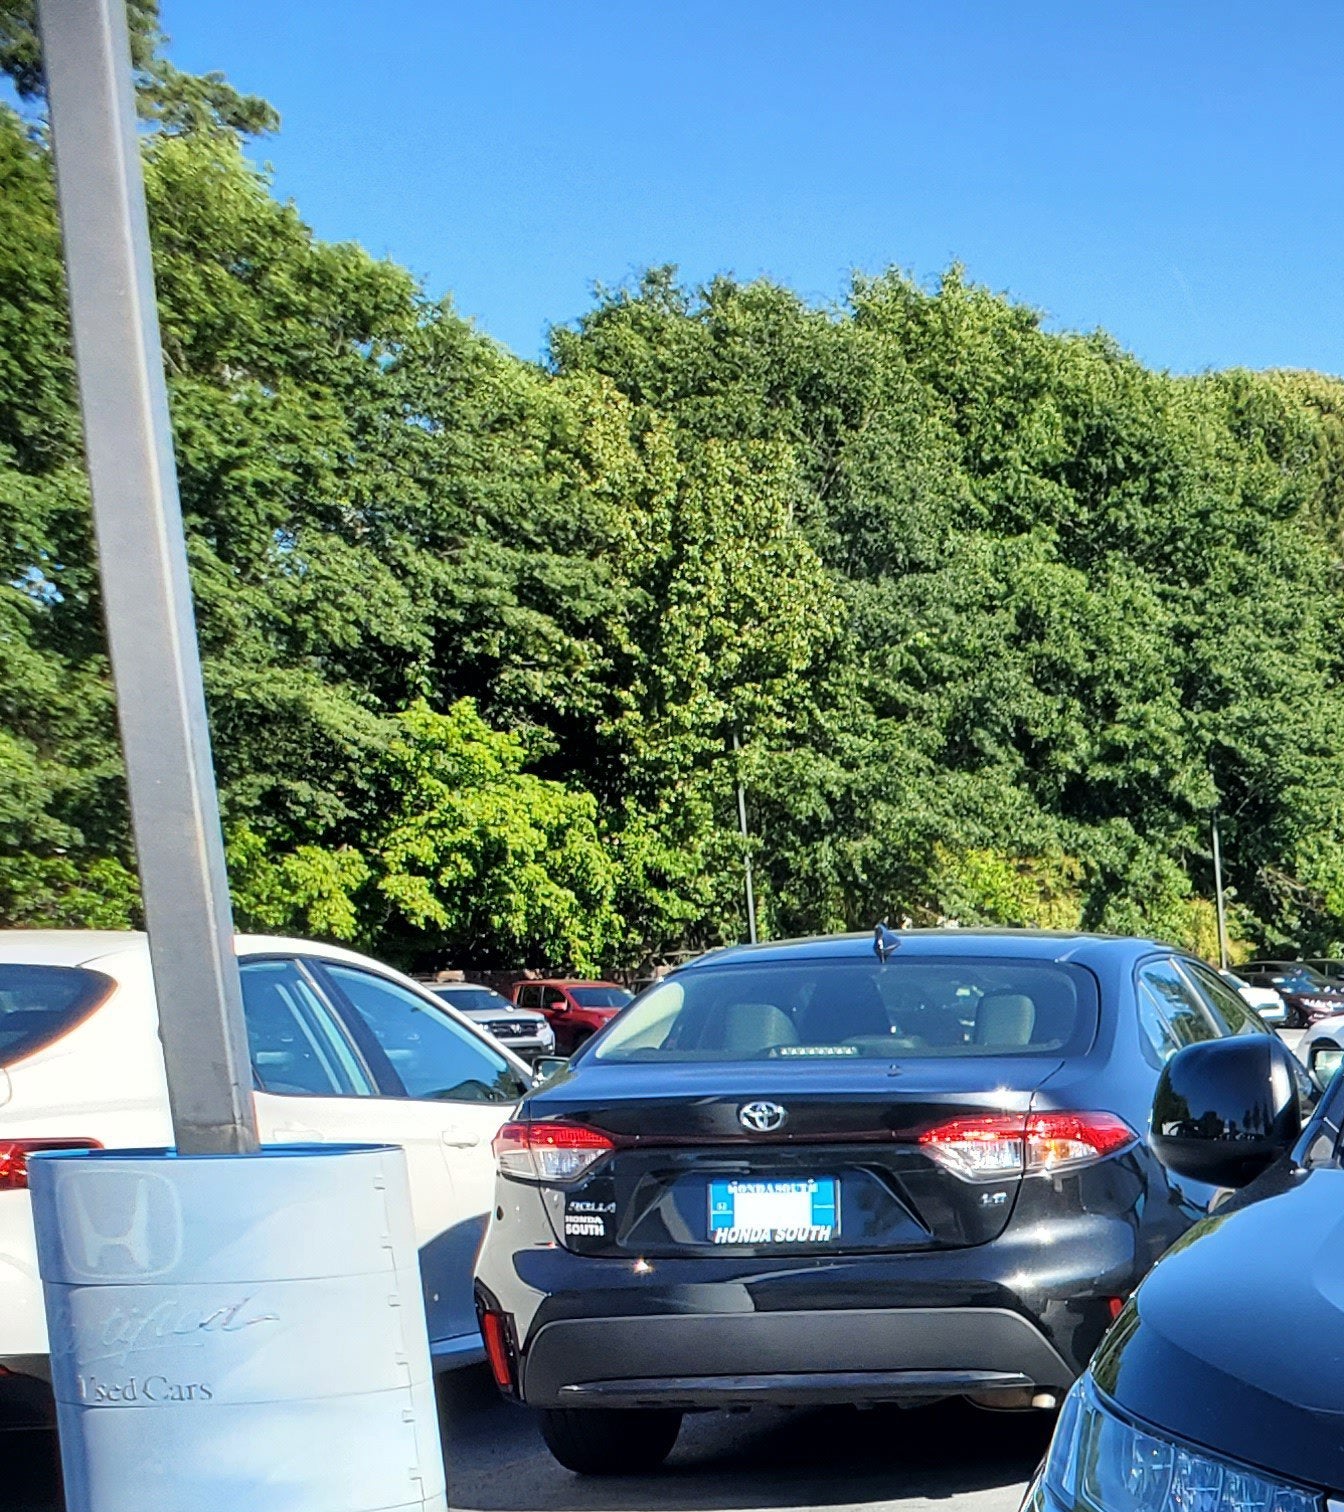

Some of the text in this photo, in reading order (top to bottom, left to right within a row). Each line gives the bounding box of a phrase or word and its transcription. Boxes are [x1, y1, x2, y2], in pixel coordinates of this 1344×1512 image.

[565, 1214, 604, 1224] HONDA
[565, 1223, 605, 1237] SOUTH
[715, 1224, 832, 1244] HONDA SOUTH
[77, 1374, 214, 1402] Used Cars
